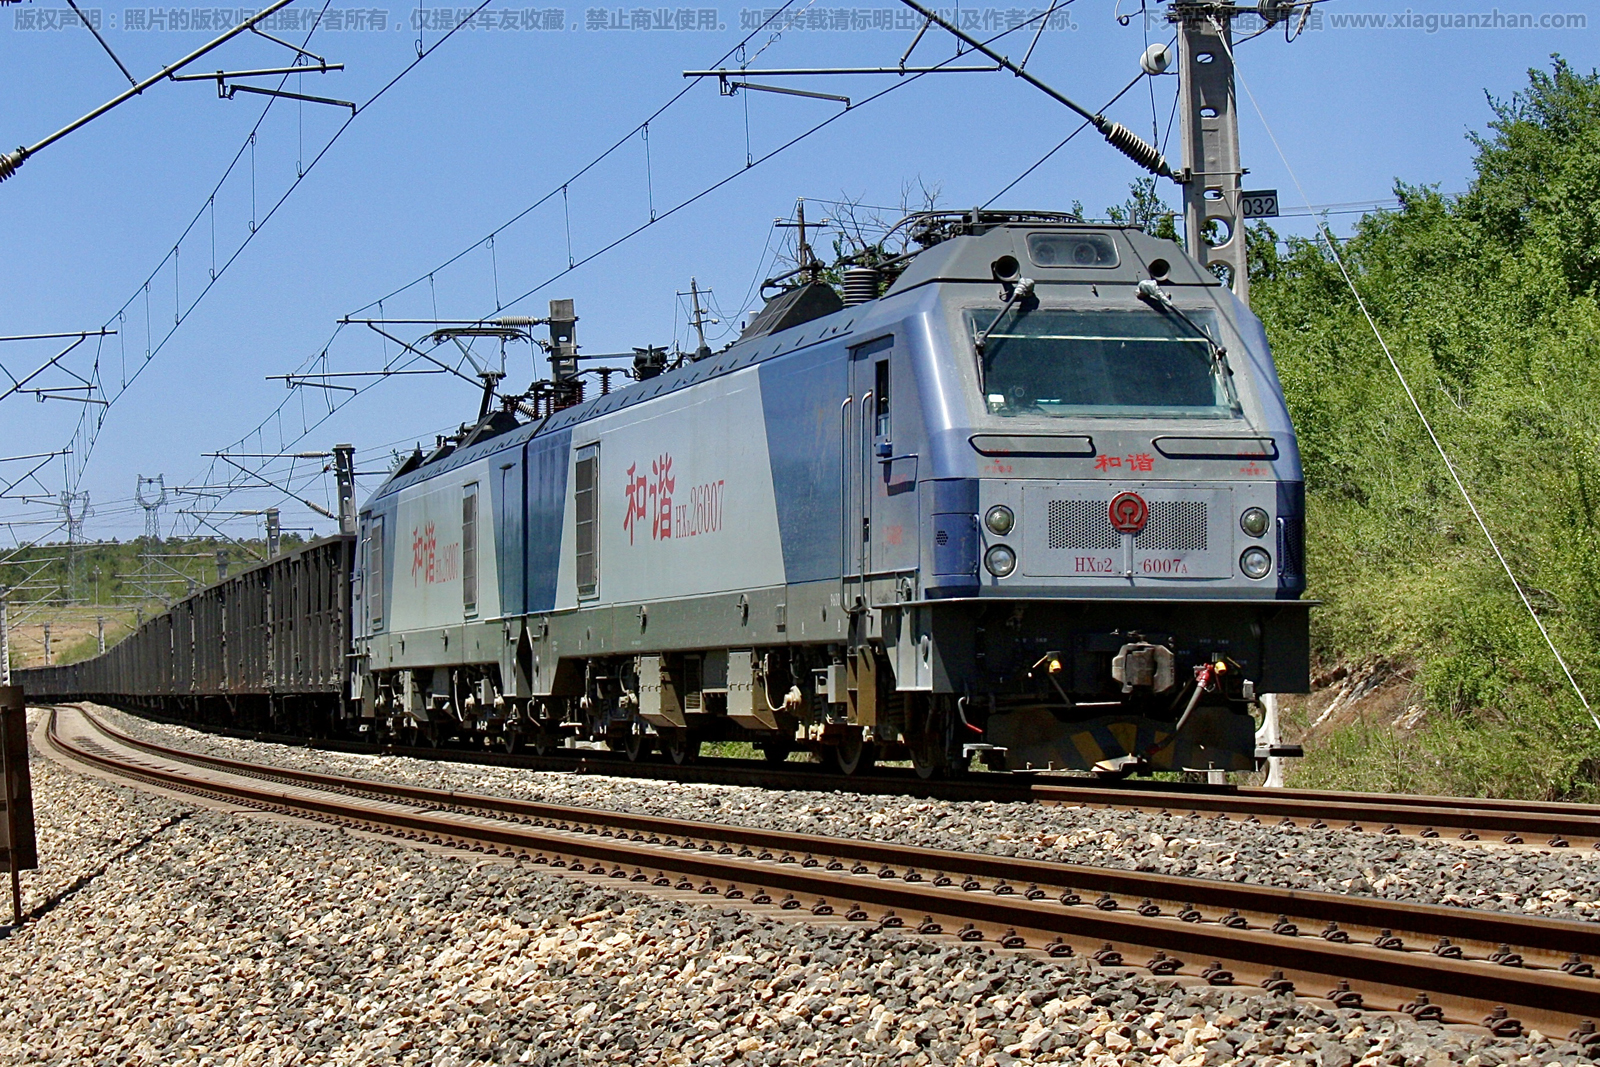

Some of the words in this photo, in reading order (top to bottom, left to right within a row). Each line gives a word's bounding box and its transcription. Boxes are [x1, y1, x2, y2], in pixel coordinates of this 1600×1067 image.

[1242, 197, 1276, 215] 032
[1094, 453, 1154, 472] 和谐
[623, 452, 675, 546] 和谐
[1075, 557, 1112, 573] HXD2
